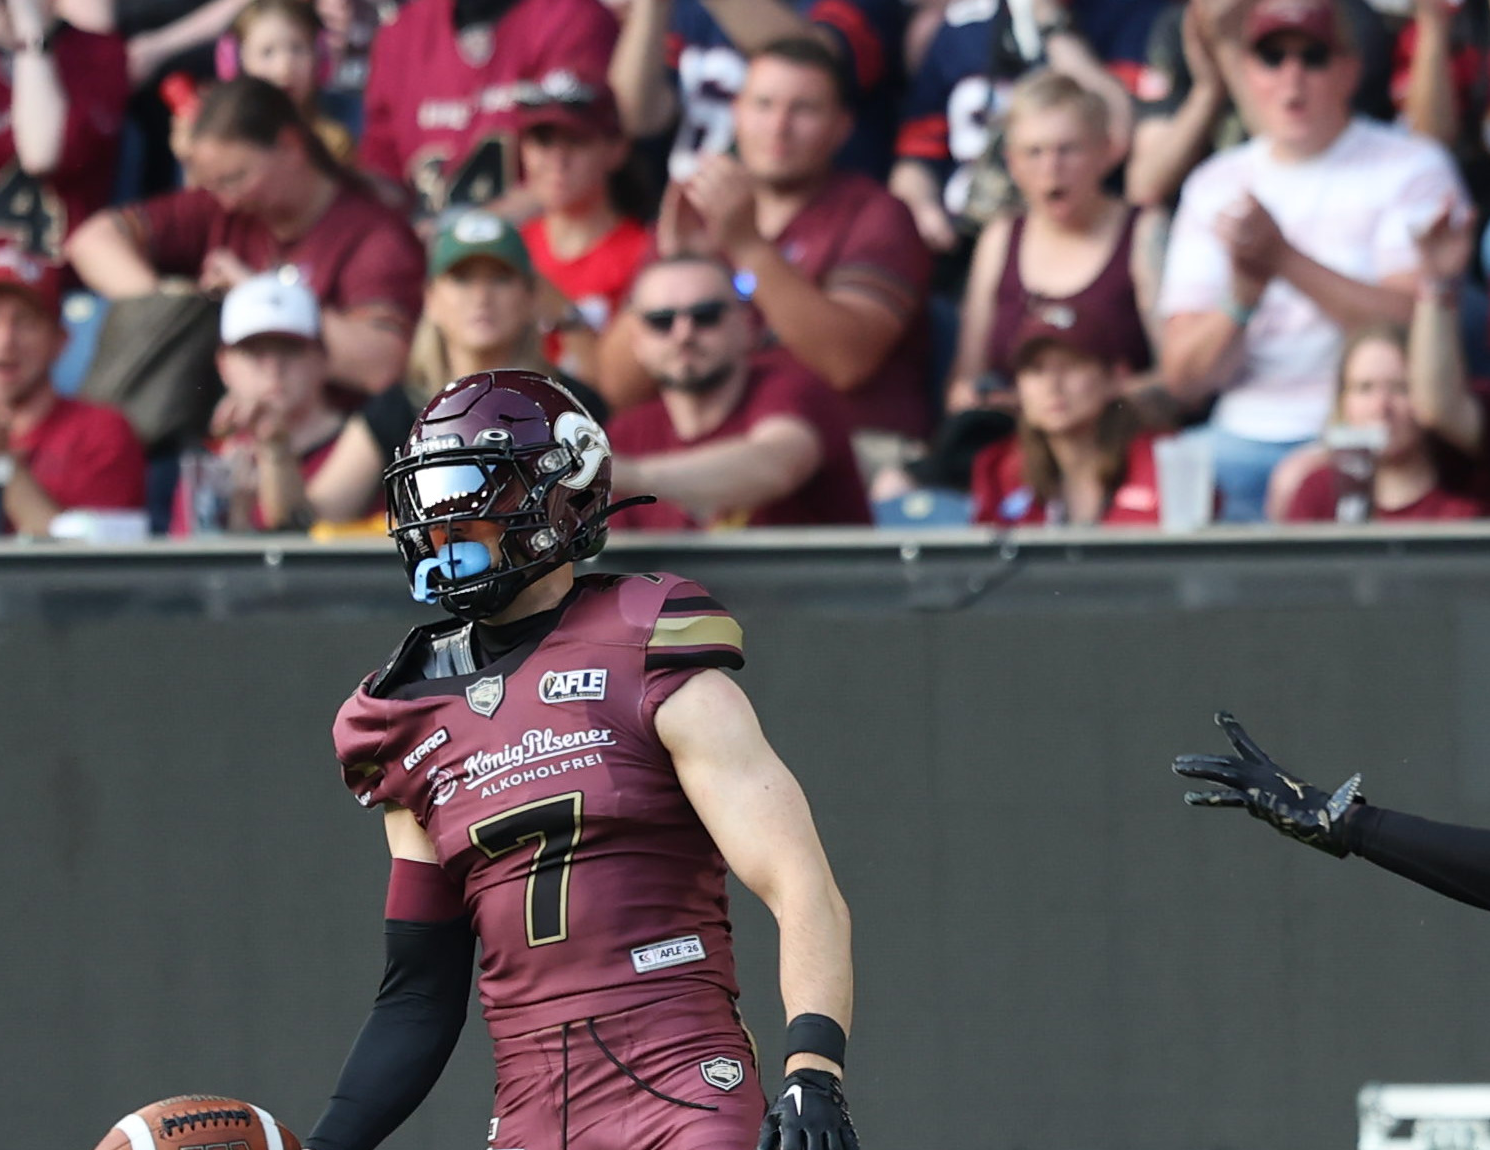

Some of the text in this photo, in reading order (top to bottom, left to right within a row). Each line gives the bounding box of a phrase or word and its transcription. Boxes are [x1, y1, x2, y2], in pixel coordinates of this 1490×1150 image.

[547, 672, 604, 696] AFLE
[403, 728, 447, 771] KPRO
[462, 728, 612, 783] König Pilsener
[481, 753, 603, 799] ALKOHOLFREI
[468, 790, 583, 947] 7
